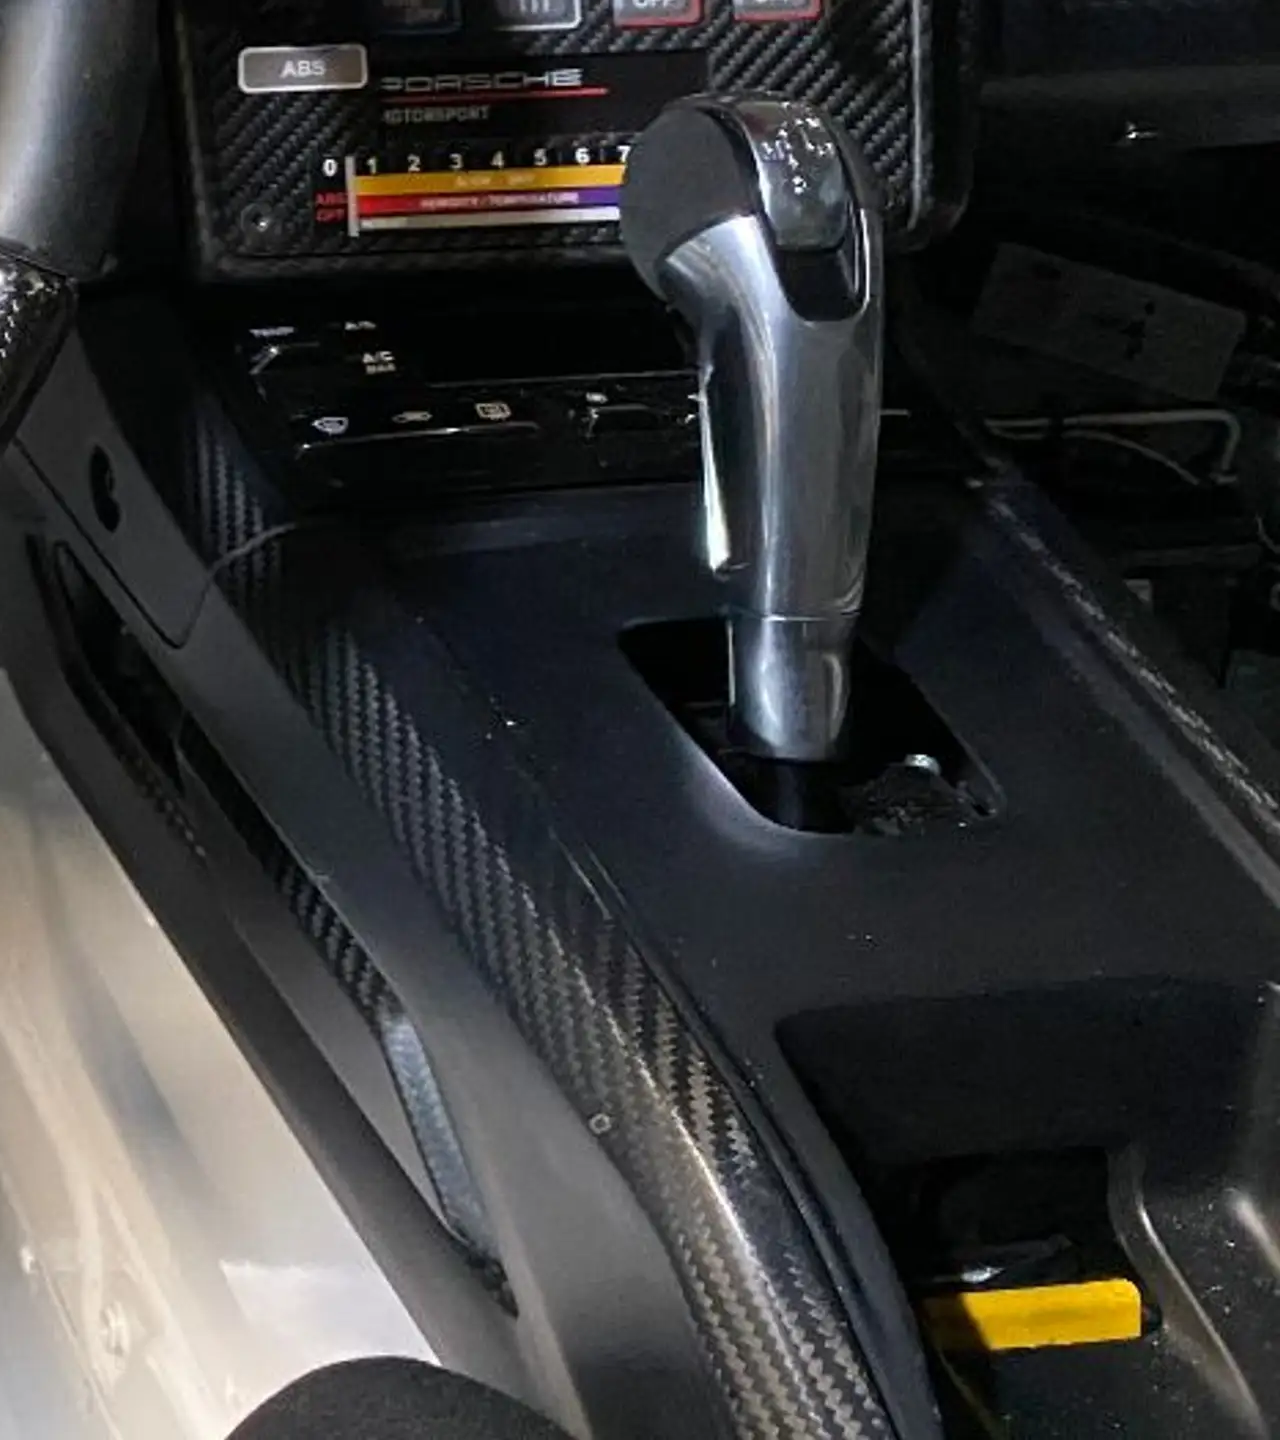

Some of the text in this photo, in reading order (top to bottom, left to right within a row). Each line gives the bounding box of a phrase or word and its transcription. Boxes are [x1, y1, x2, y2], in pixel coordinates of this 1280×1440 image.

[279, 59, 326, 78] ABS
[380, 68, 585, 92] PORSCHE
[323, 144, 632, 176] 0 1 2 3 4 5 6 7
